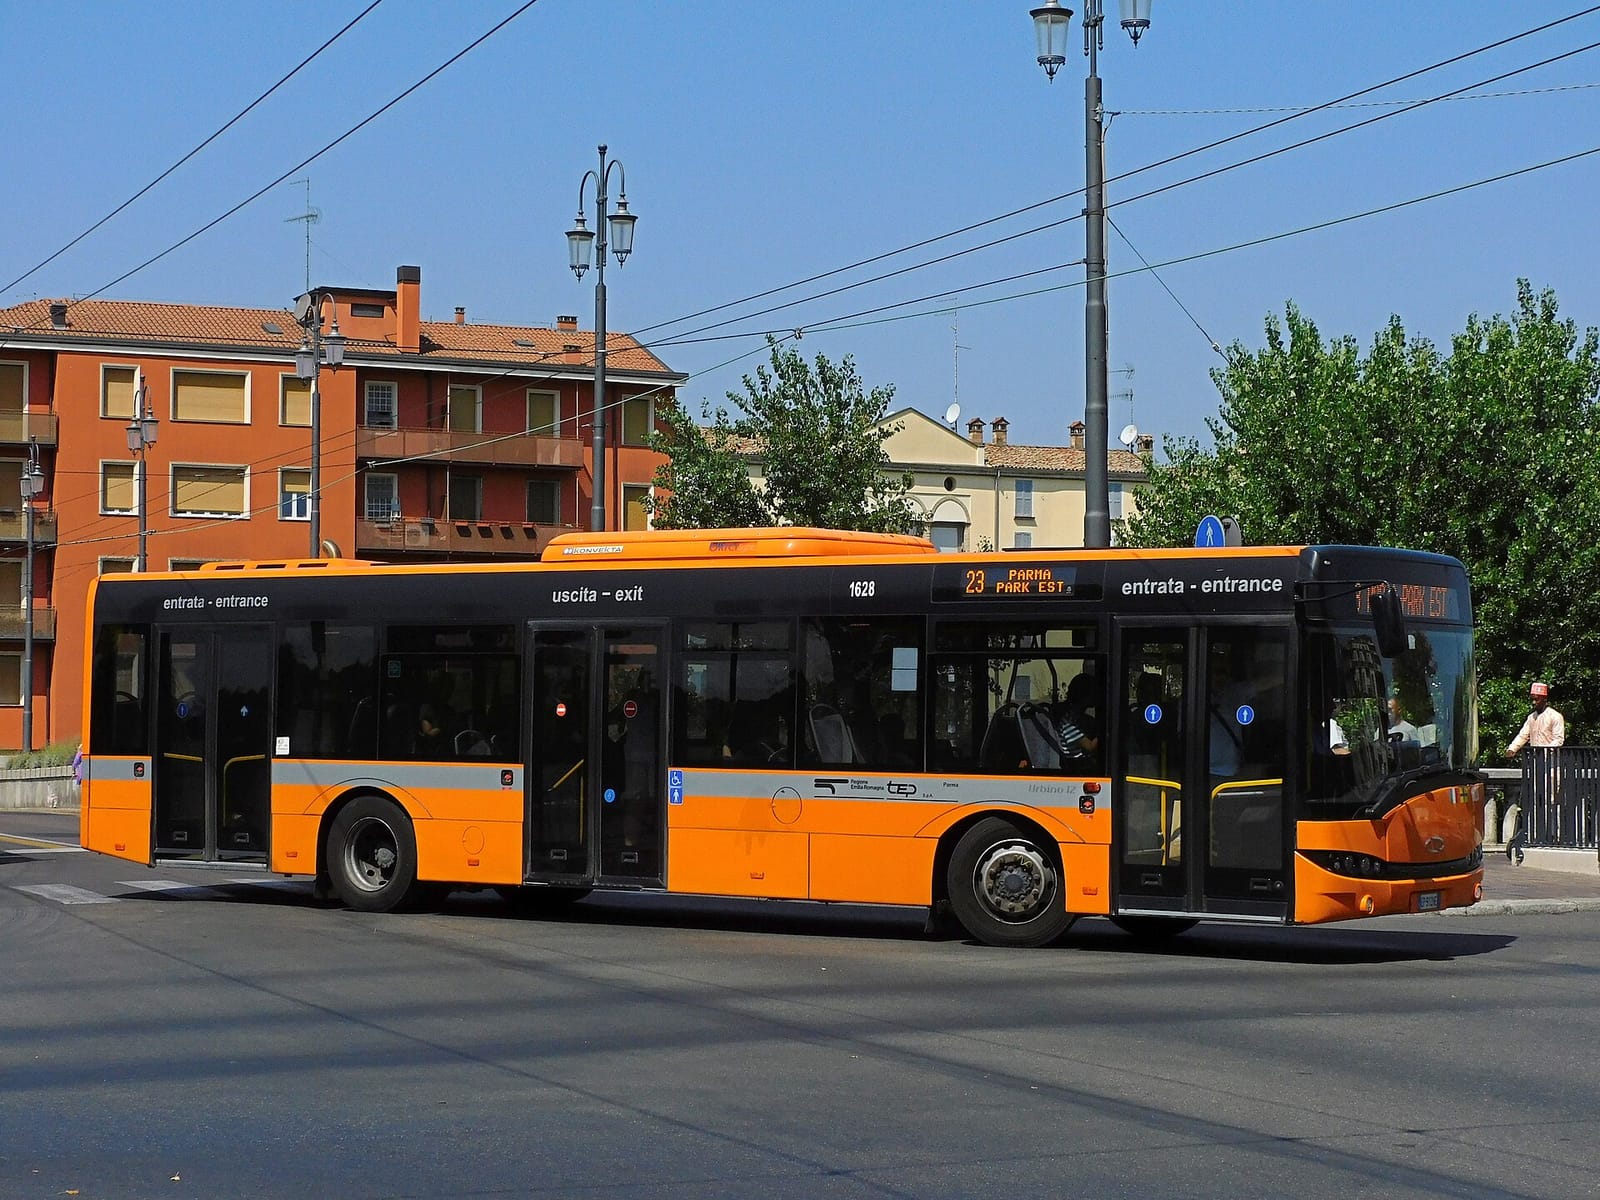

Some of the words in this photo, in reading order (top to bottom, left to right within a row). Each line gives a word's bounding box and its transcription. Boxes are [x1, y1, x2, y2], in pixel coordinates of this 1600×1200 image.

[966, 570, 985, 593] 23
[1008, 569, 1051, 580] PARMA
[552, 586, 597, 602] uscita
[615, 585, 643, 601] exit
[849, 581, 875, 597] 1628
[996, 581, 1030, 593] PARK
[1121, 577, 1185, 595] entrata
[1201, 576, 1283, 593] entrance
[163, 596, 205, 609] entrata
[215, 595, 269, 608] entrance
